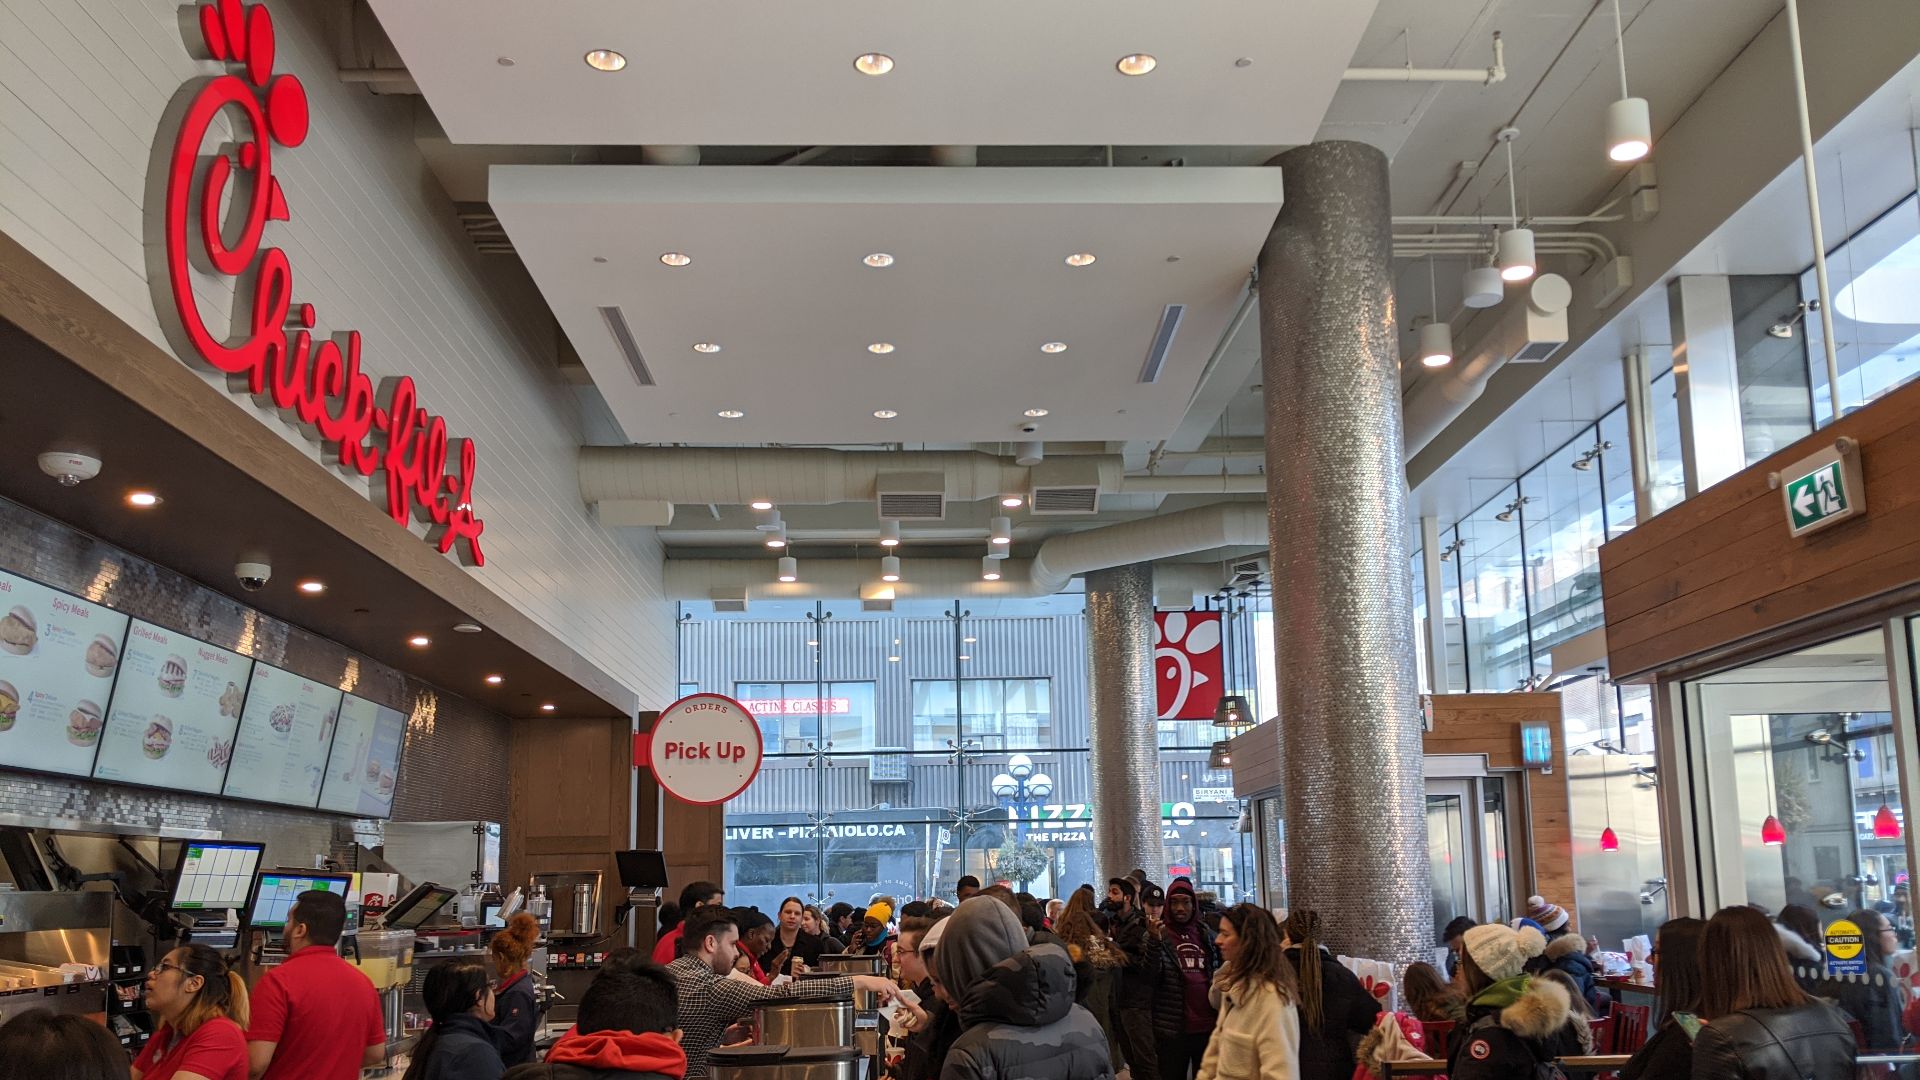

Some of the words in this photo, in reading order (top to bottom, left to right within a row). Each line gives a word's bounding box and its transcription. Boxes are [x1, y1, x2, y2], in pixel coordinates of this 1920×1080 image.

[52, 597, 70, 613] Spicy
[71, 603, 89, 618] Meals
[152, 631, 168, 646] Meals
[684, 703, 729, 714] ORDERS
[664, 741, 711, 760] Pick
[717, 741, 746, 763] Up
[1025, 833, 1050, 842] THE
[1051, 832, 1087, 842] PIZZA
[1829, 936, 1860, 944] CAUTION
